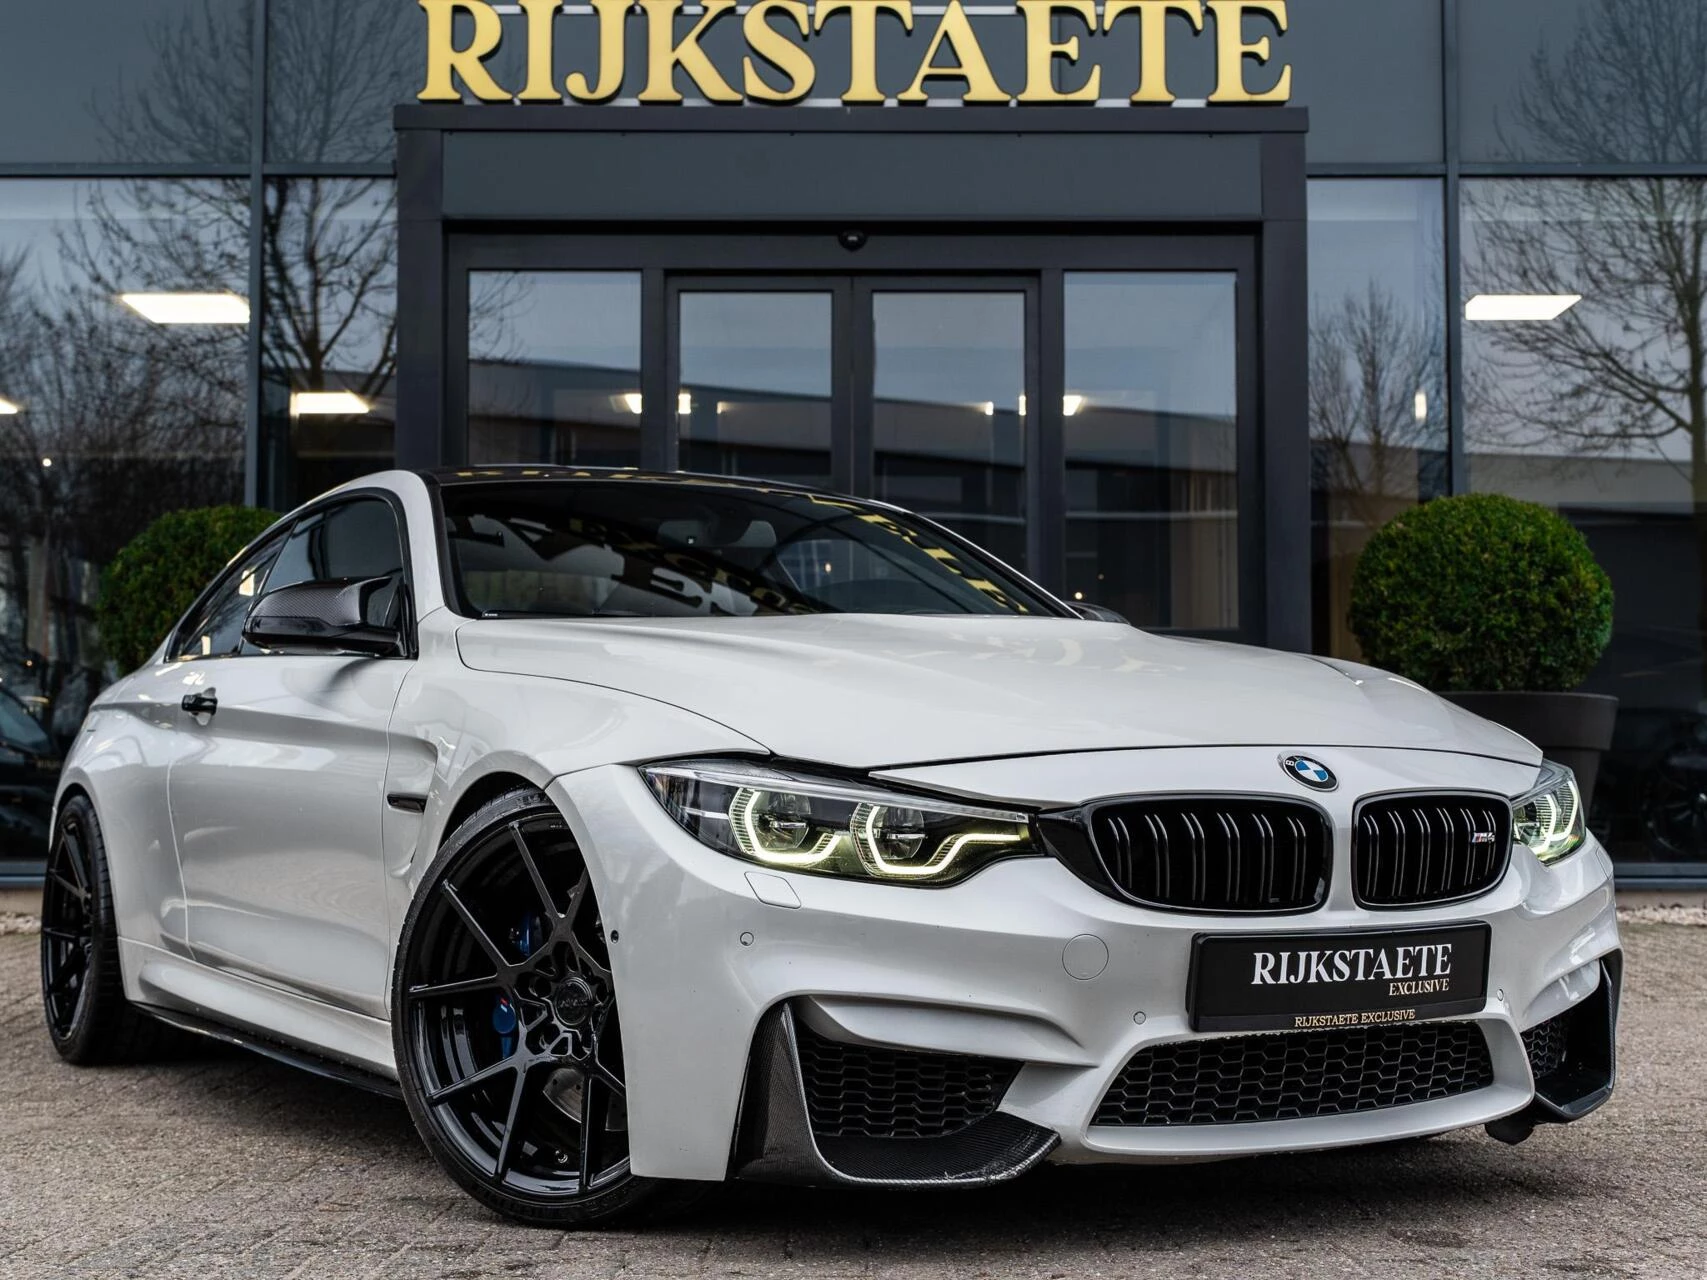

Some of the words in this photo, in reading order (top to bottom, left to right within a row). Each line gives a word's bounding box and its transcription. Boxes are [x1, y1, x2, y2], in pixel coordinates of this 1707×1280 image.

[415, 0, 1292, 103] RIJKSTAETE
[1251, 943, 1453, 985] RIJKSTAETE
[1388, 978, 1450, 997] EXCLUSIVE
[1294, 1013, 1359, 1028] RIJKSTAETE
[1360, 1009, 1416, 1024] EXCLUSIVE
